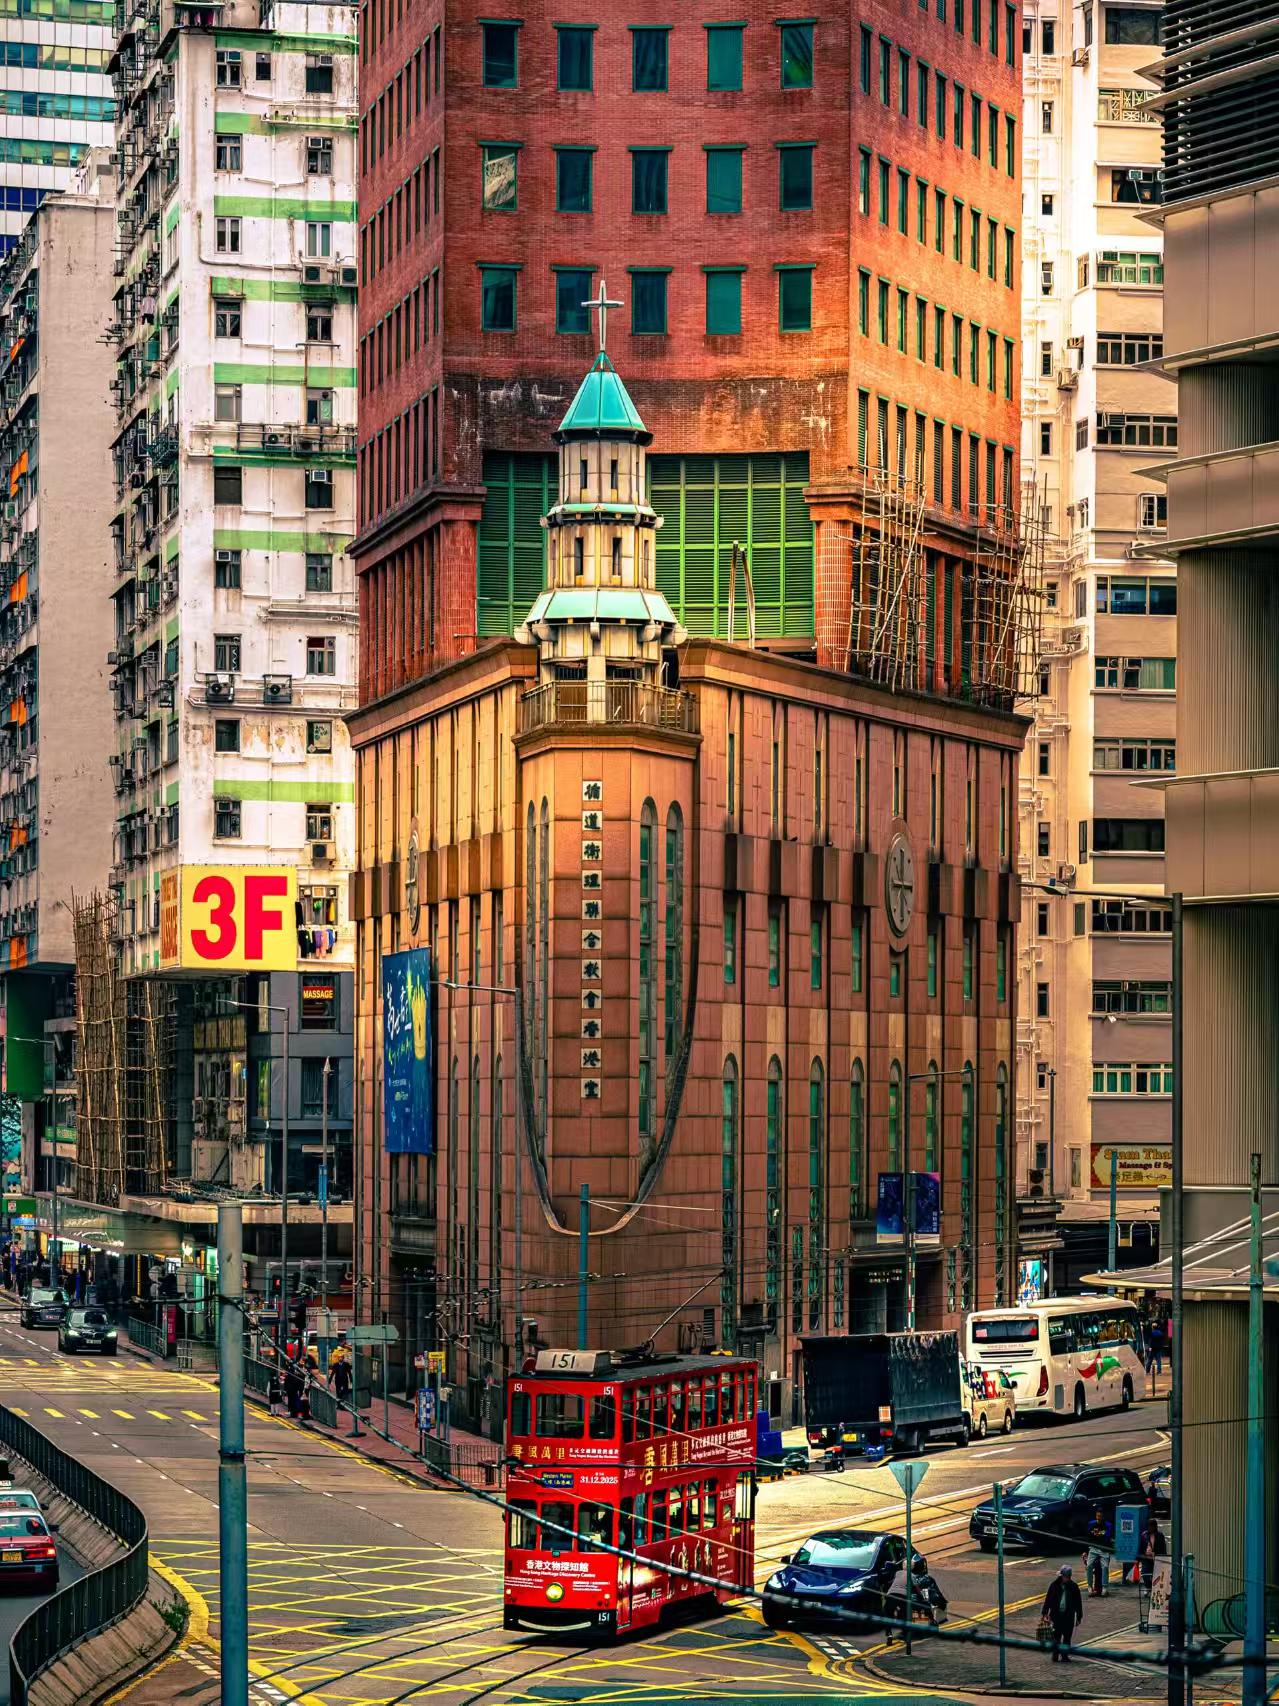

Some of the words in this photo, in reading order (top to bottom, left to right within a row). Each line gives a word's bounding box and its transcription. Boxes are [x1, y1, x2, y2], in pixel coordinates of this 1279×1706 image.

[190, 875, 288, 960] 3F
[303, 989, 334, 999] MASSAGE
[1119, 1162, 1153, 1170] Massage
[551, 1353, 577, 1369] 151
[513, 1383, 523, 1392] 151
[603, 1386, 614, 1395] 151
[580, 1475, 618, 1484] 31.12.2025
[526, 1559, 589, 1572] 香港文物探知館
[598, 1612, 610, 1622] 151
